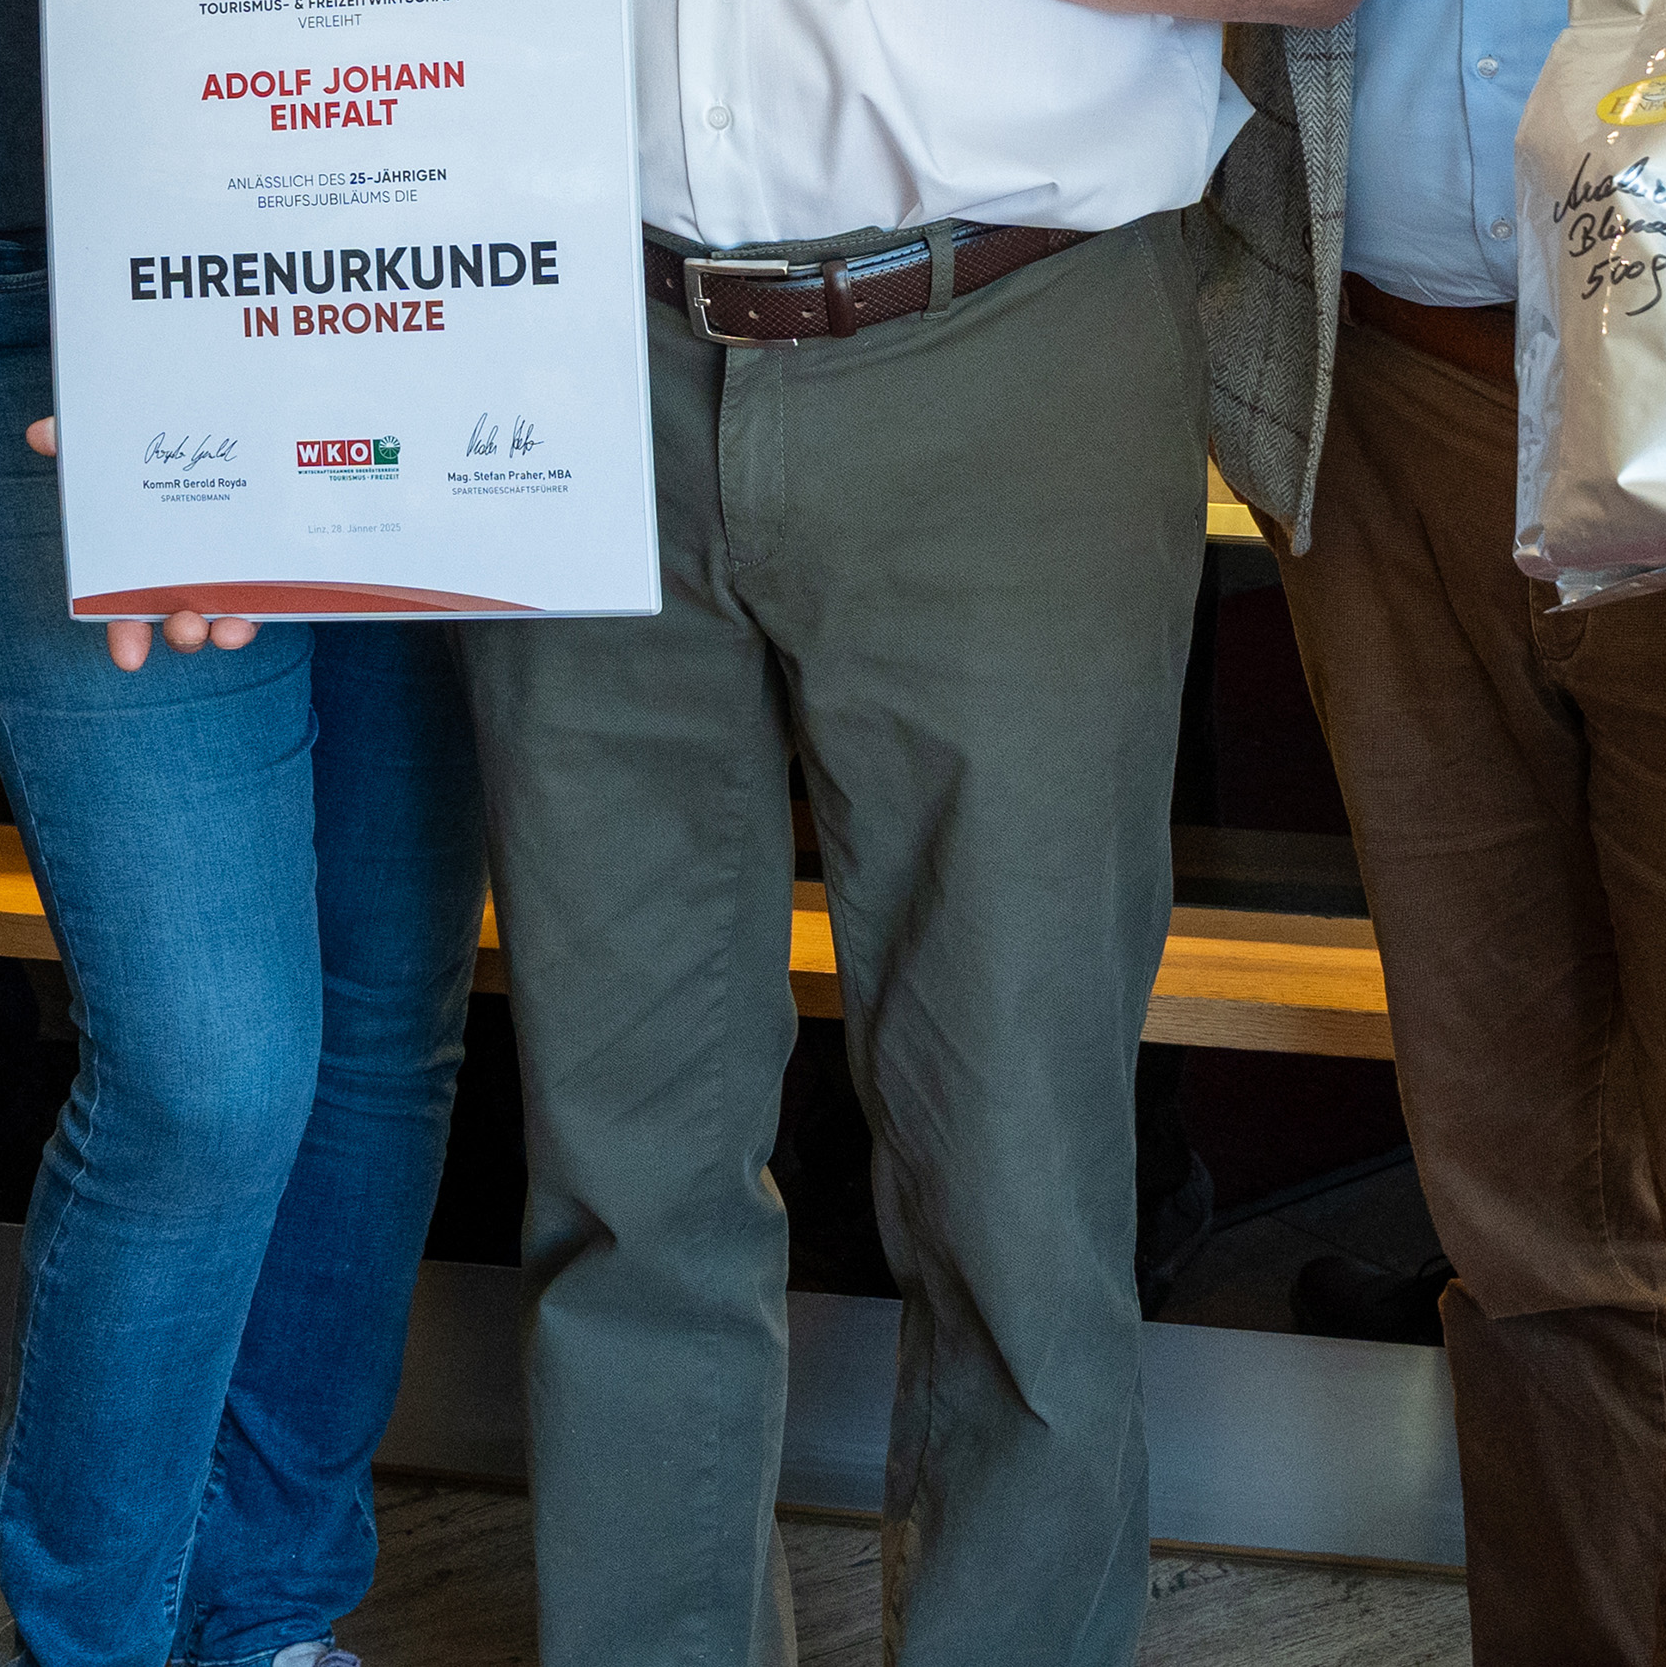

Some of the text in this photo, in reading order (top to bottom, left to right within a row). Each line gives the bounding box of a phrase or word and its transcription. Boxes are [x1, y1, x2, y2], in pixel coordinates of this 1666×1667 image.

[199, 0, 290, 15] TOURISMUS-
[298, 14, 363, 29] VERLEIHT
[201, 60, 466, 101] ADOLF JOHANN
[270, 98, 399, 132] EINFALT
[227, 168, 448, 191] ANLÄSSLICH DES 25-JÄHRIGEN
[258, 189, 418, 209] BERUFSJUBILÄUMS DIE
[129, 240, 561, 301] EHRENURKUNDE
[243, 300, 446, 338] IN BRONZE
[297, 441, 371, 465] WKO
[142, 477, 247, 490] KommR Gerold Royda
[370, 473, 400, 481] FREIZEIT
[447, 469, 573, 484] Mag. Stefan Praher, MBA
[451, 484, 569, 496] SPARTENGESCHÄFTSFÜHRER
[160, 493, 231, 503] SPARTENOBMANN
[307, 525, 330, 535] Linz,
[346, 523, 378, 533] Jänner
[379, 522, 402, 533] 2025
